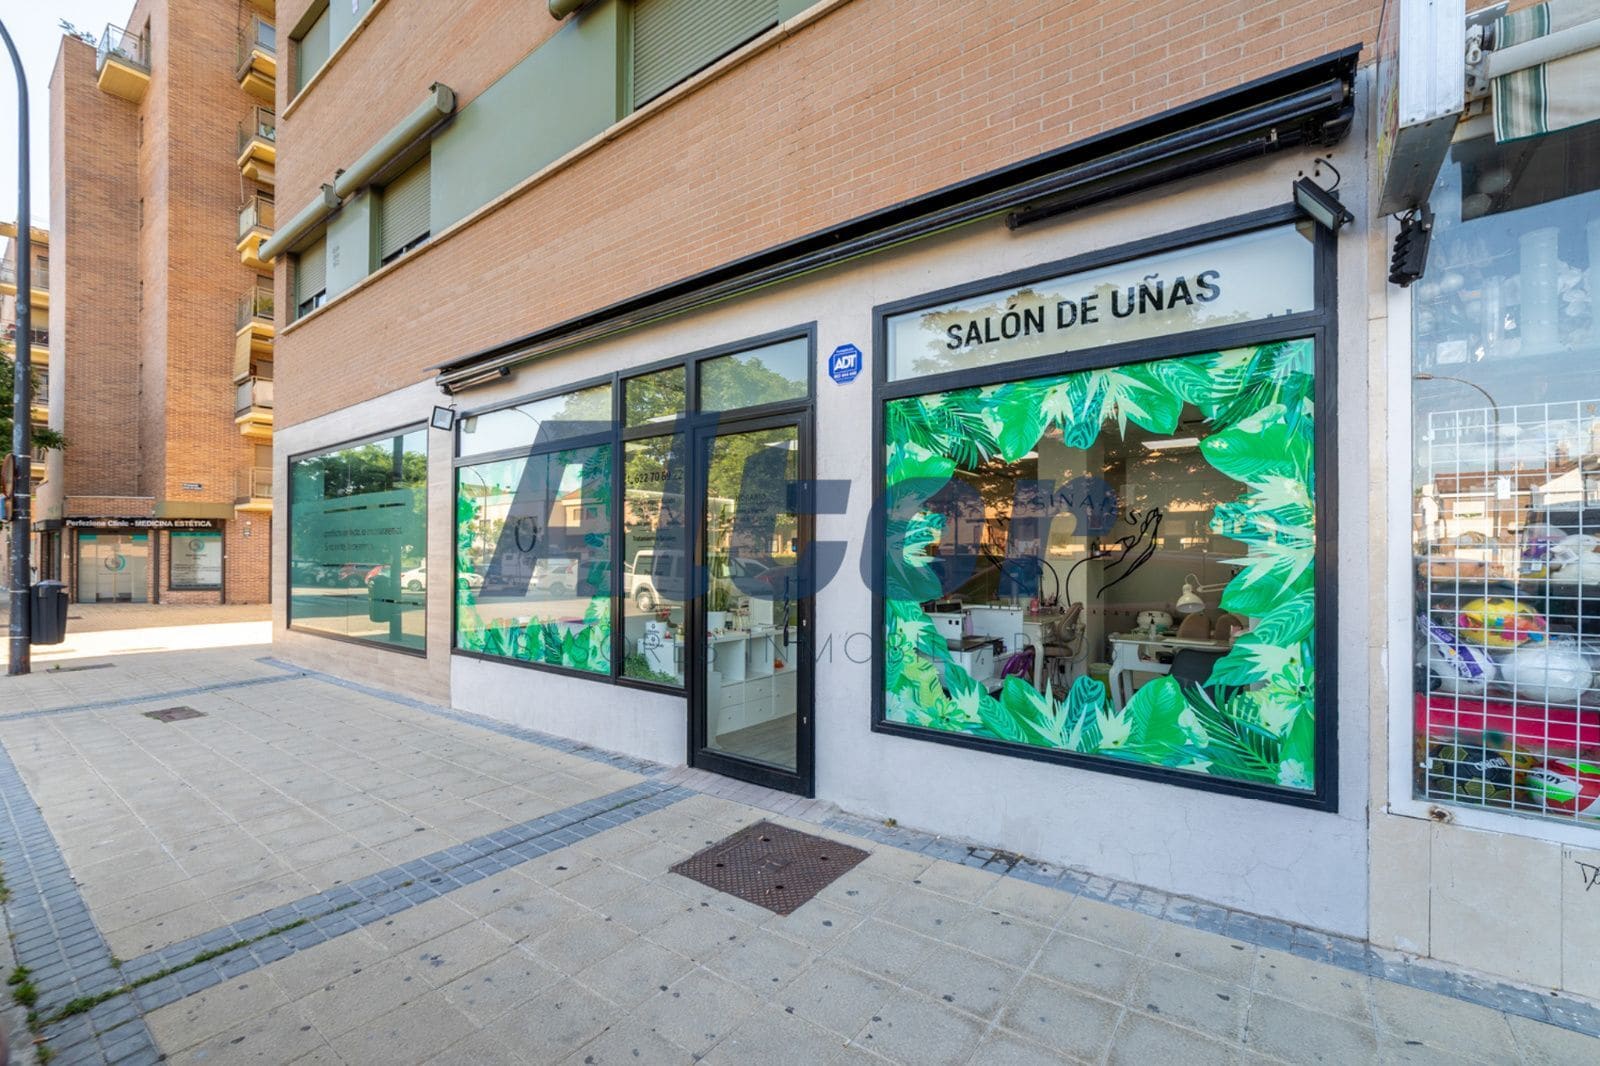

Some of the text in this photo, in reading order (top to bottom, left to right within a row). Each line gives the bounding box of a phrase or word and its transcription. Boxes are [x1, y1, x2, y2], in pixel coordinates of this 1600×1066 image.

[946, 270, 1221, 350] SALÓN DE UÑAS
[833, 354, 857, 371] ADT
[634, 472, 649, 484] 622
[650, 471, 660, 482] 70
[134, 519, 173, 528] MEDICINA
[174, 518, 212, 528] ESTÉTICA
